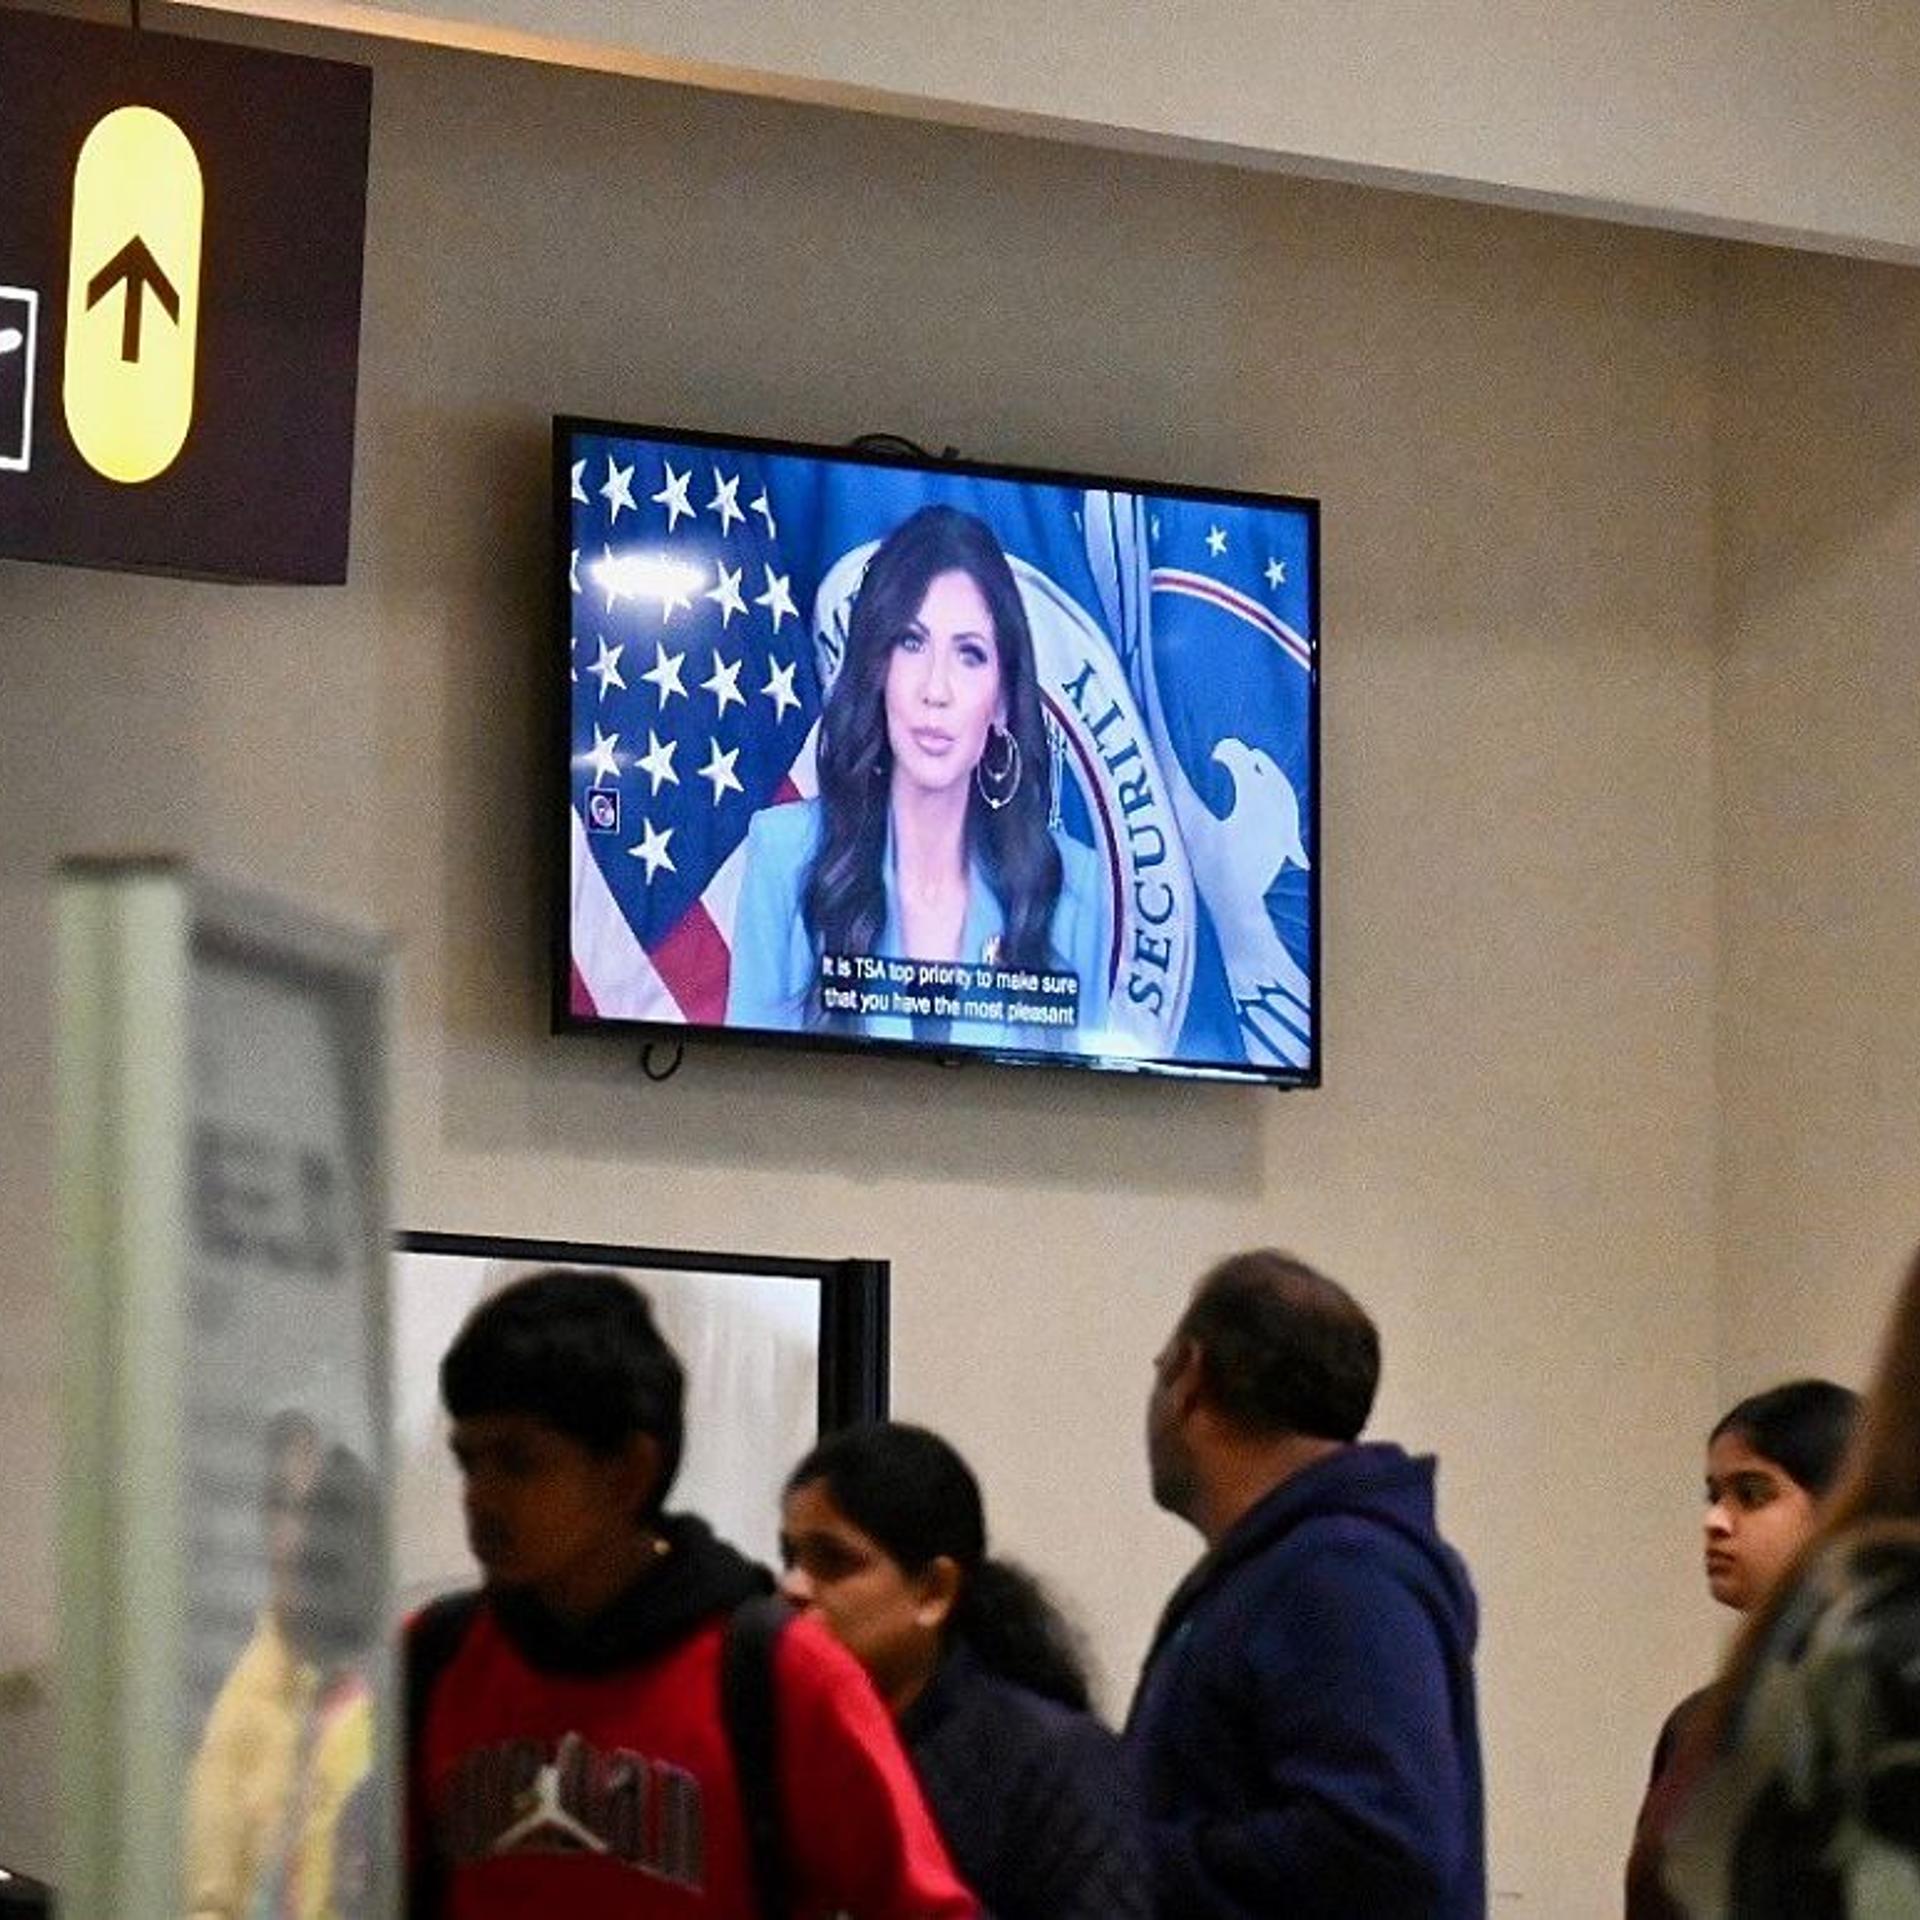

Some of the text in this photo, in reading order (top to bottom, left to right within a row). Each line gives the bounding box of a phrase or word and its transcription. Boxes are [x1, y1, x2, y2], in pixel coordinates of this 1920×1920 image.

[1062, 658, 1174, 1015] SECURITY
[838, 957, 851, 977] is
[854, 957, 886, 979] TSA
[889, 963, 914, 986] top
[919, 965, 971, 990] priority
[977, 969, 991, 988] to
[997, 971, 1038, 991] make
[1042, 977, 1077, 994] sure
[825, 987, 1074, 1025] that you have the most pleasant
